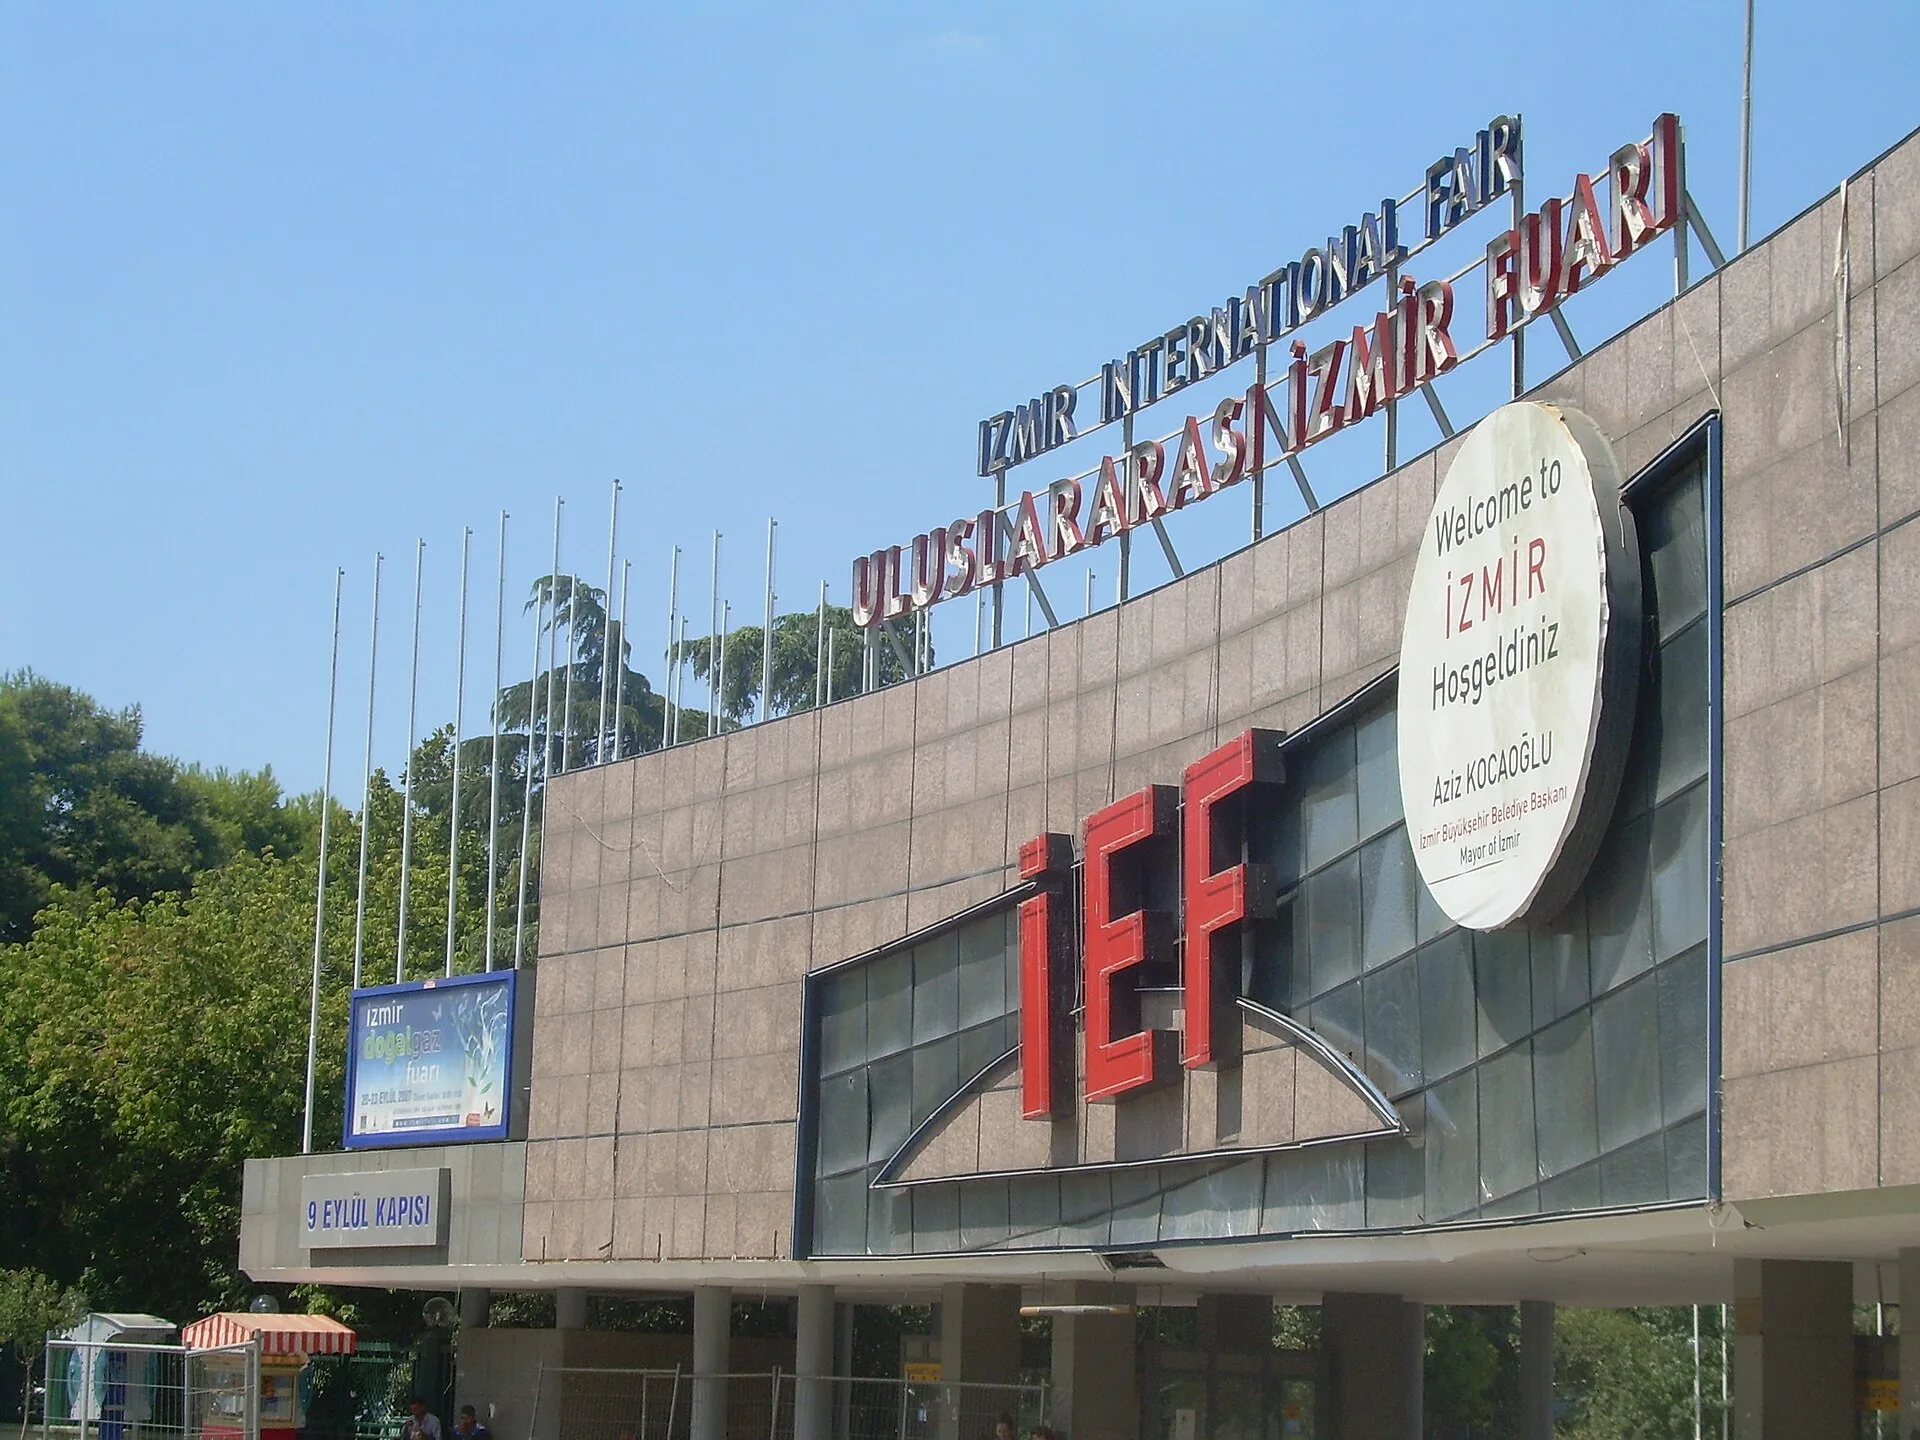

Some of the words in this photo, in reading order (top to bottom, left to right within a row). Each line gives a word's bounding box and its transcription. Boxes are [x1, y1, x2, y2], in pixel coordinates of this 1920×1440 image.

[977, 384, 1079, 477] IZMIR
[1100, 198, 1408, 424] INTERNATIONAL
[1425, 114, 1522, 240] FAIR
[852, 383, 1265, 627] ULUSLARARASI
[1287, 275, 1457, 452] İZMİR
[1486, 113, 1680, 341] FUARI
[1436, 475, 1532, 557] Welcome
[1540, 457, 1562, 499] to
[1446, 535, 1546, 640] İZMİR
[1432, 615, 1559, 711] Hoşgeldiniz
[1433, 769, 1462, 807] Aziz
[1466, 731, 1552, 795] KOCAOĞLU
[1419, 825, 1441, 850] İzmir
[1442, 809, 1490, 843] Büyükşehir
[1491, 798, 1528, 826] Belediye
[1530, 784, 1568, 812] Başkanı
[1460, 843, 1486, 866] Mayor
[1488, 836, 1497, 856] of
[1498, 829, 1521, 852] İzmir
[366, 1000, 404, 1027] izmir
[406, 1061, 440, 1085] fuarı
[307, 1200, 317, 1230] 9
[322, 1191, 368, 1230] EYLÜL
[375, 1195, 430, 1227] KAPISI
